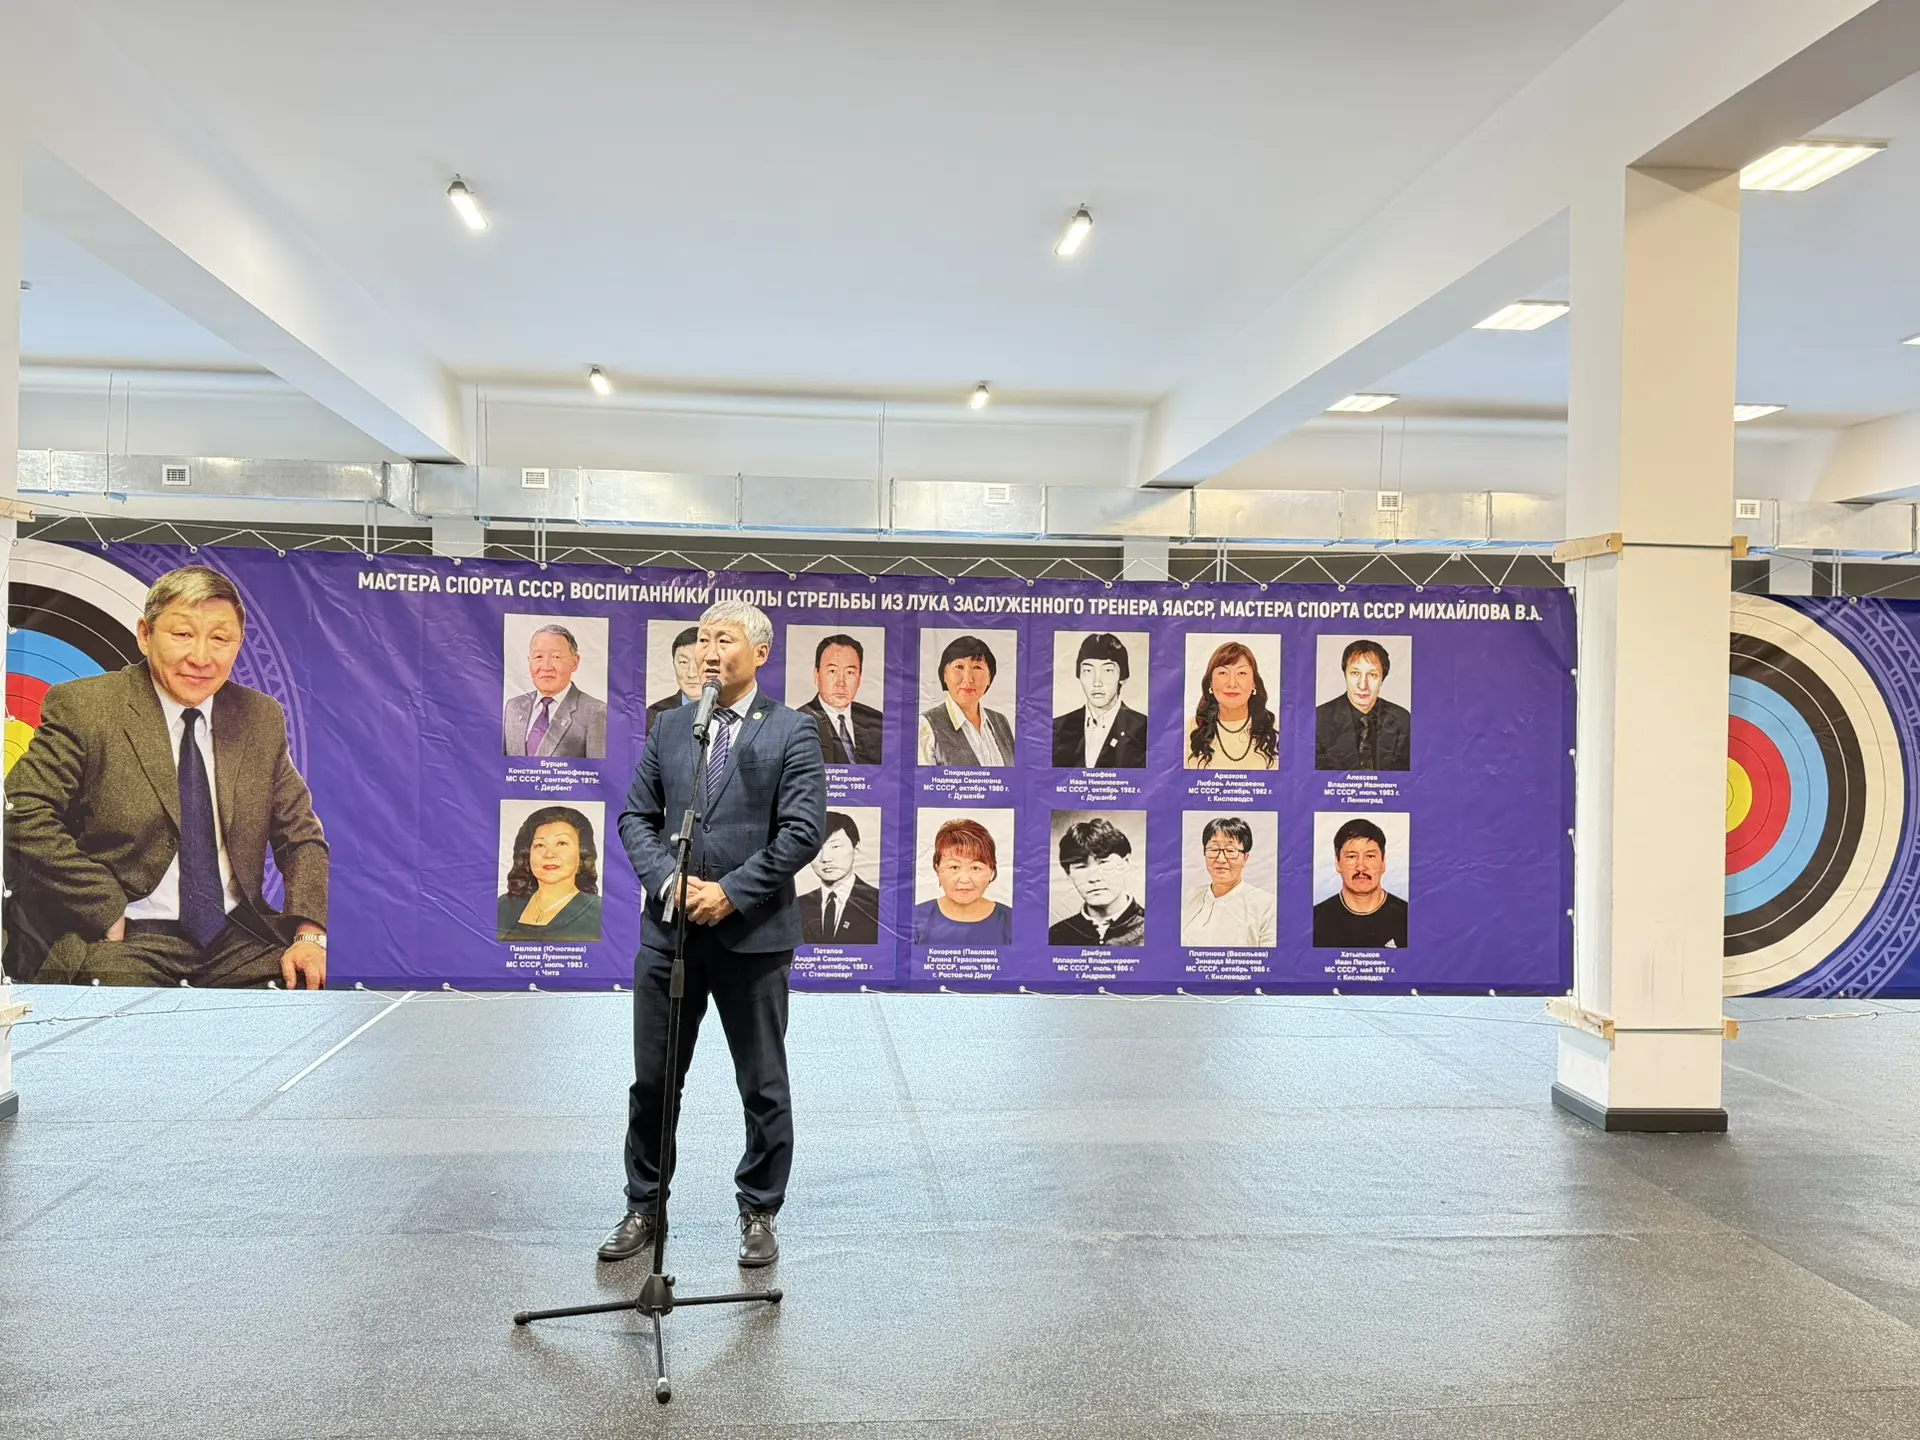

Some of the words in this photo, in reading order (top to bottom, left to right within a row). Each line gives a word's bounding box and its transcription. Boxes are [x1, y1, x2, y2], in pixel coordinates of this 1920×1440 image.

[358, 572, 440, 592] МАСТЕРА
[446, 576, 514, 596] СПОРТА
[519, 579, 565, 601] СССР,
[570, 581, 709, 604] ВОСПИТАННИКИ
[715, 588, 782, 606] ШКОЛЫ
[788, 590, 875, 610] СТРЕЛЬБЫ
[882, 592, 902, 611] ИЗ
[906, 593, 949, 612] ЛУКА
[954, 595, 1084, 614] ЗАСЛУЖЕННОГО
[1090, 598, 1158, 616] ТРЕНЕРА
[1162, 600, 1216, 619] ЯАССР,
[1221, 600, 1294, 618] МАСТЕРА
[1298, 601, 1360, 619] СПОРТА
[1364, 602, 1404, 619] СССР
[1409, 600, 1510, 620] МИХАЙЛОВА
[1515, 604, 1542, 622] В.А.
[540, 760, 568, 768] Бурцев
[1082, 771, 1116, 779] Тимофеев
[1214, 772, 1247, 780] Аржакова
[541, 784, 572, 792] Дербент
[1086, 794, 1117, 802] Душанбе
[962, 948, 997, 956] (Павлова)
[1081, 949, 1111, 957] Дамбуев
[1227, 950, 1268, 958] (Васильева)
[809, 971, 853, 979] Степанокерт
[1211, 973, 1251, 981] Кисловодск
